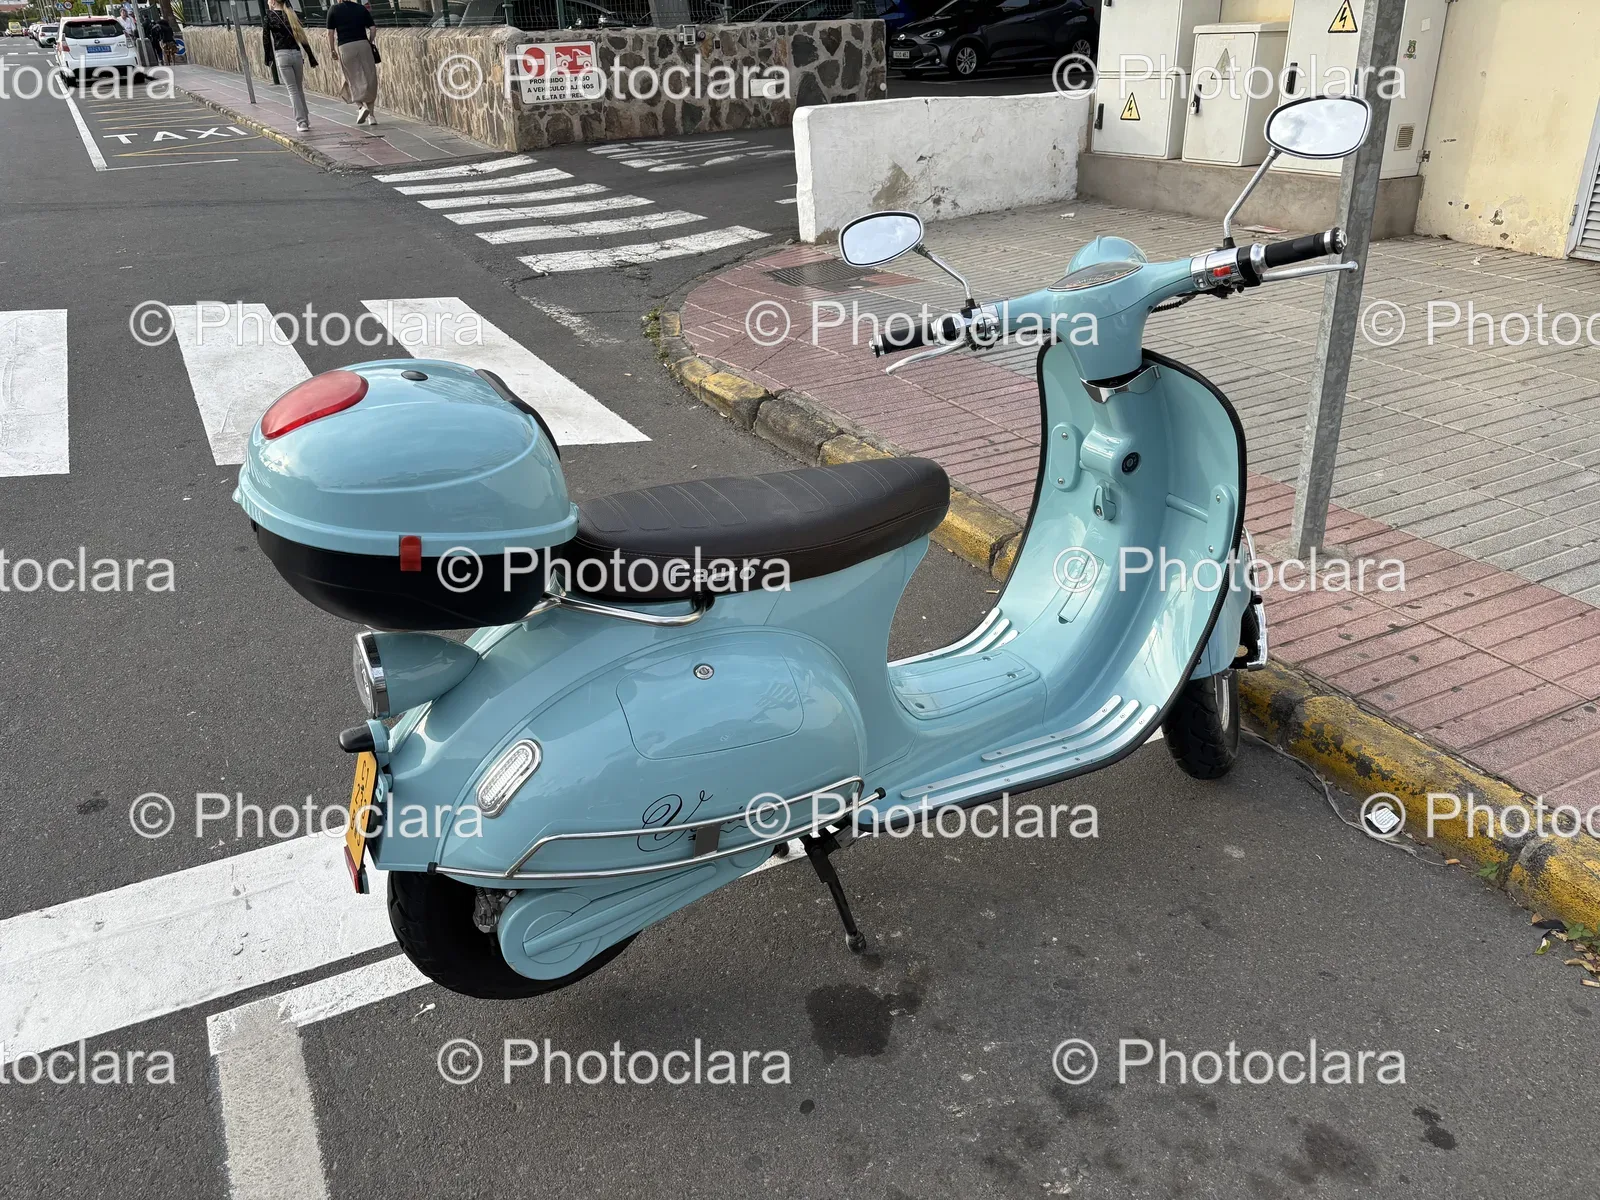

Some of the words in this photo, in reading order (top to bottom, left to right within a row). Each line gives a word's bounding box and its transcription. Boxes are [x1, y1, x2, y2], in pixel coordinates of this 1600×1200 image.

[529, 77, 564, 85] PROHBIDO
[533, 85, 569, 93] VEHCULO
[103, 126, 248, 145] TAXI
